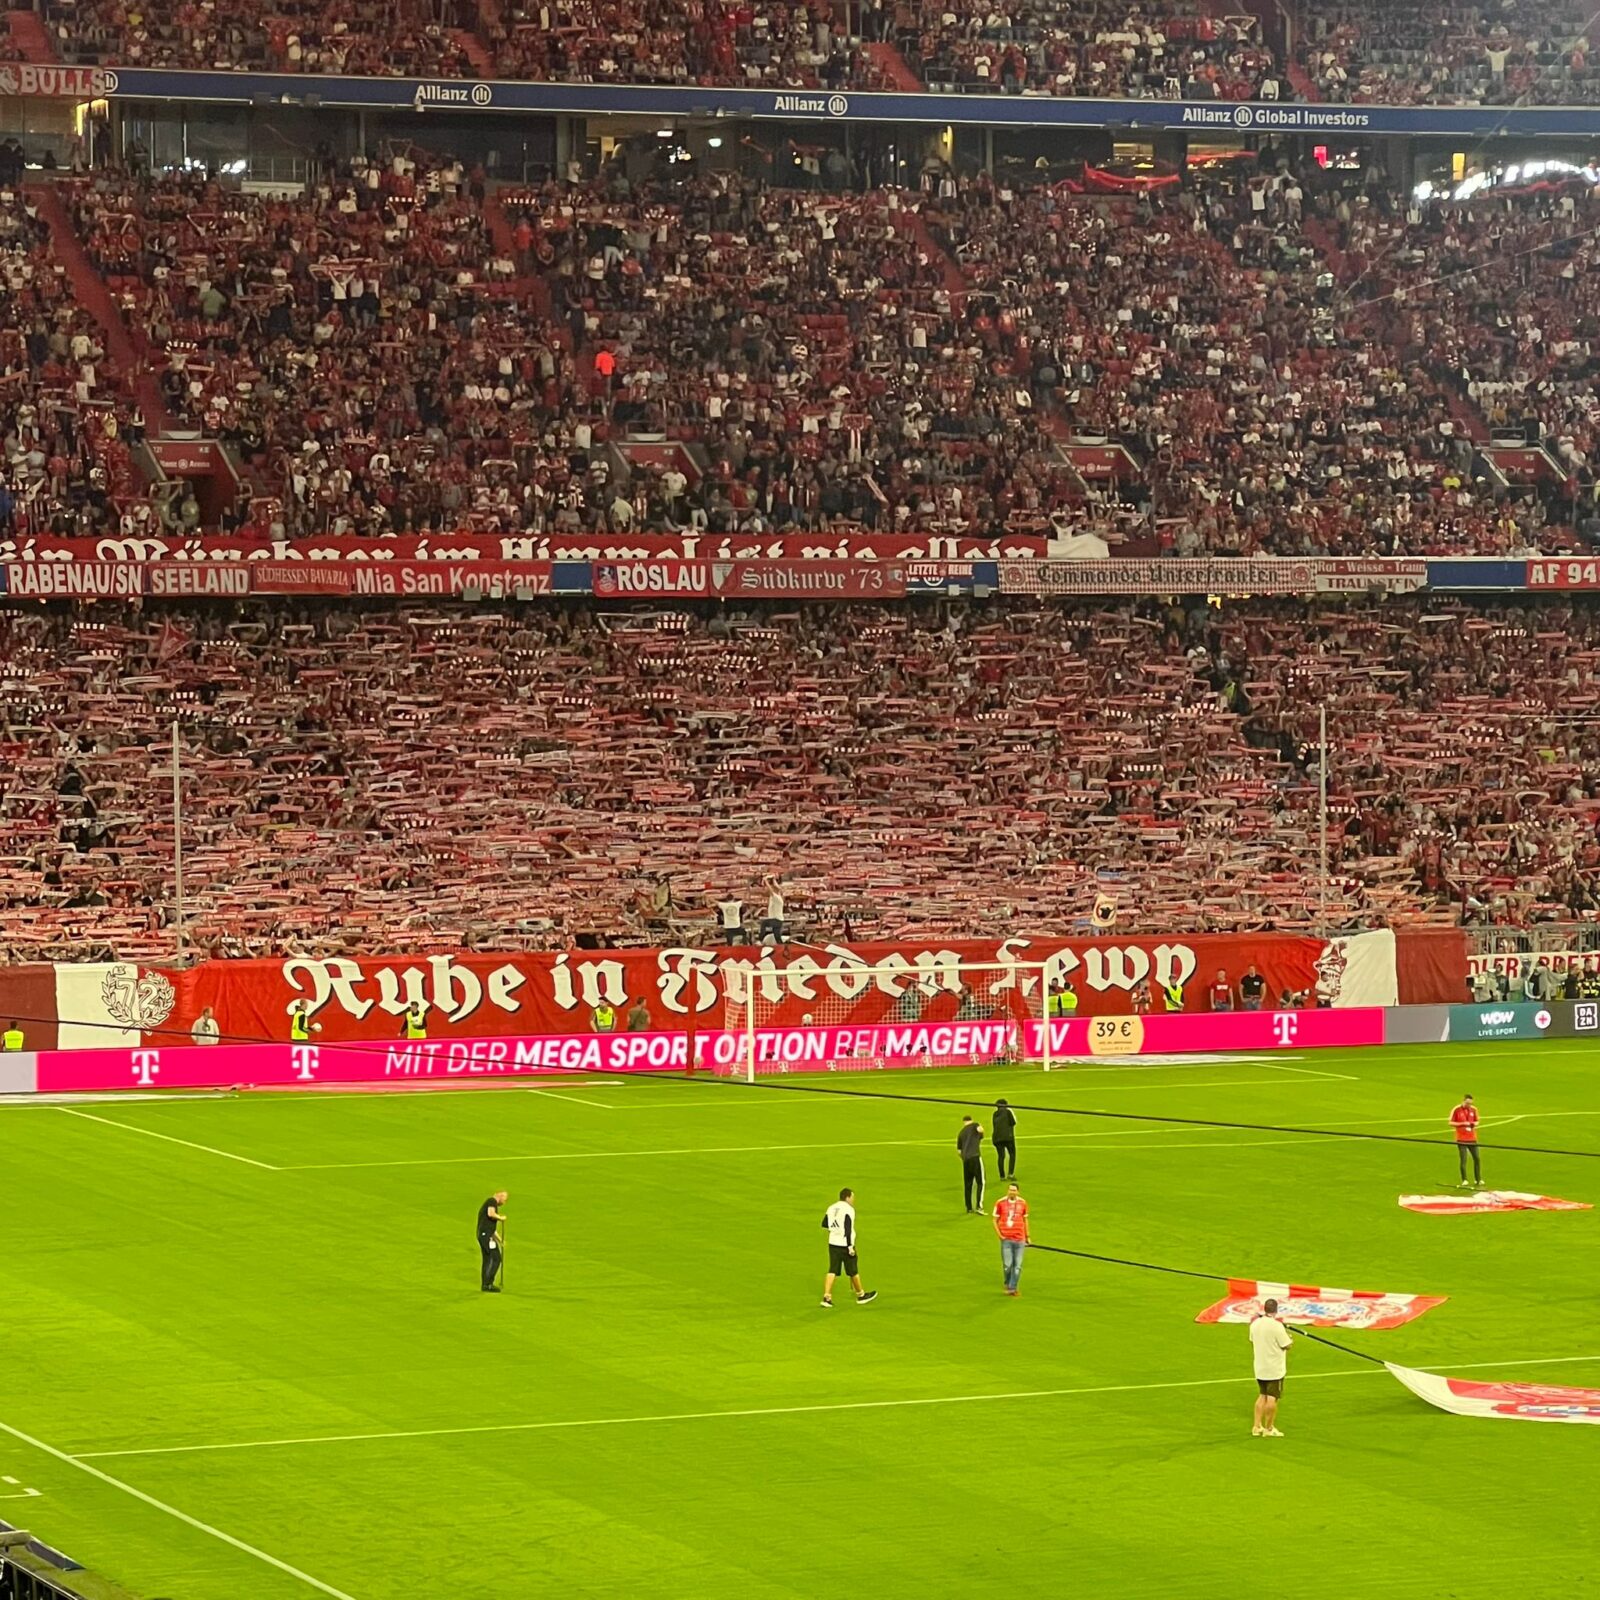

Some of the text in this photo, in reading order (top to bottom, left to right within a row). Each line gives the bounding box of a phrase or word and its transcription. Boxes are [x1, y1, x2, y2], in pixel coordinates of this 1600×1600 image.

[20, 65, 106, 96] BULLS
[415, 84, 468, 102] Allianz
[774, 96, 825, 112] Allianz
[1183, 108, 1369, 127] Allianz Global Investors
[9, 563, 142, 594] RABENAU/SN
[152, 567, 248, 594] SEELAND
[256, 564, 348, 586] SÜDHESSEN BAVARIA
[356, 566, 549, 594] Mia San Konstanz
[616, 562, 706, 591] RÖSLAU
[741, 567, 883, 590] Südkurve '73
[908, 563, 938, 576] LETZTE
[1037, 564, 1278, 588] Commando Unterfranken
[1530, 563, 1597, 584] AF 94
[281, 954, 527, 1023] Ruhe
[549, 952, 629, 1010] in
[656, 944, 964, 1014] Frieden
[1096, 1021, 1116, 1037] 39
[1273, 1012, 1298, 1045] T
[1480, 1011, 1515, 1025] WOW
[385, 1047, 442, 1075] MIT
[446, 1043, 508, 1073] DER
[514, 1039, 602, 1071] MEGA
[608, 1033, 710, 1067] SPORT
[713, 1031, 827, 1064] OPTION
[833, 1030, 879, 1059] BEI
[1031, 1022, 1071, 1052] TV
[131, 1051, 160, 1085] T
[290, 1046, 319, 1080] T
